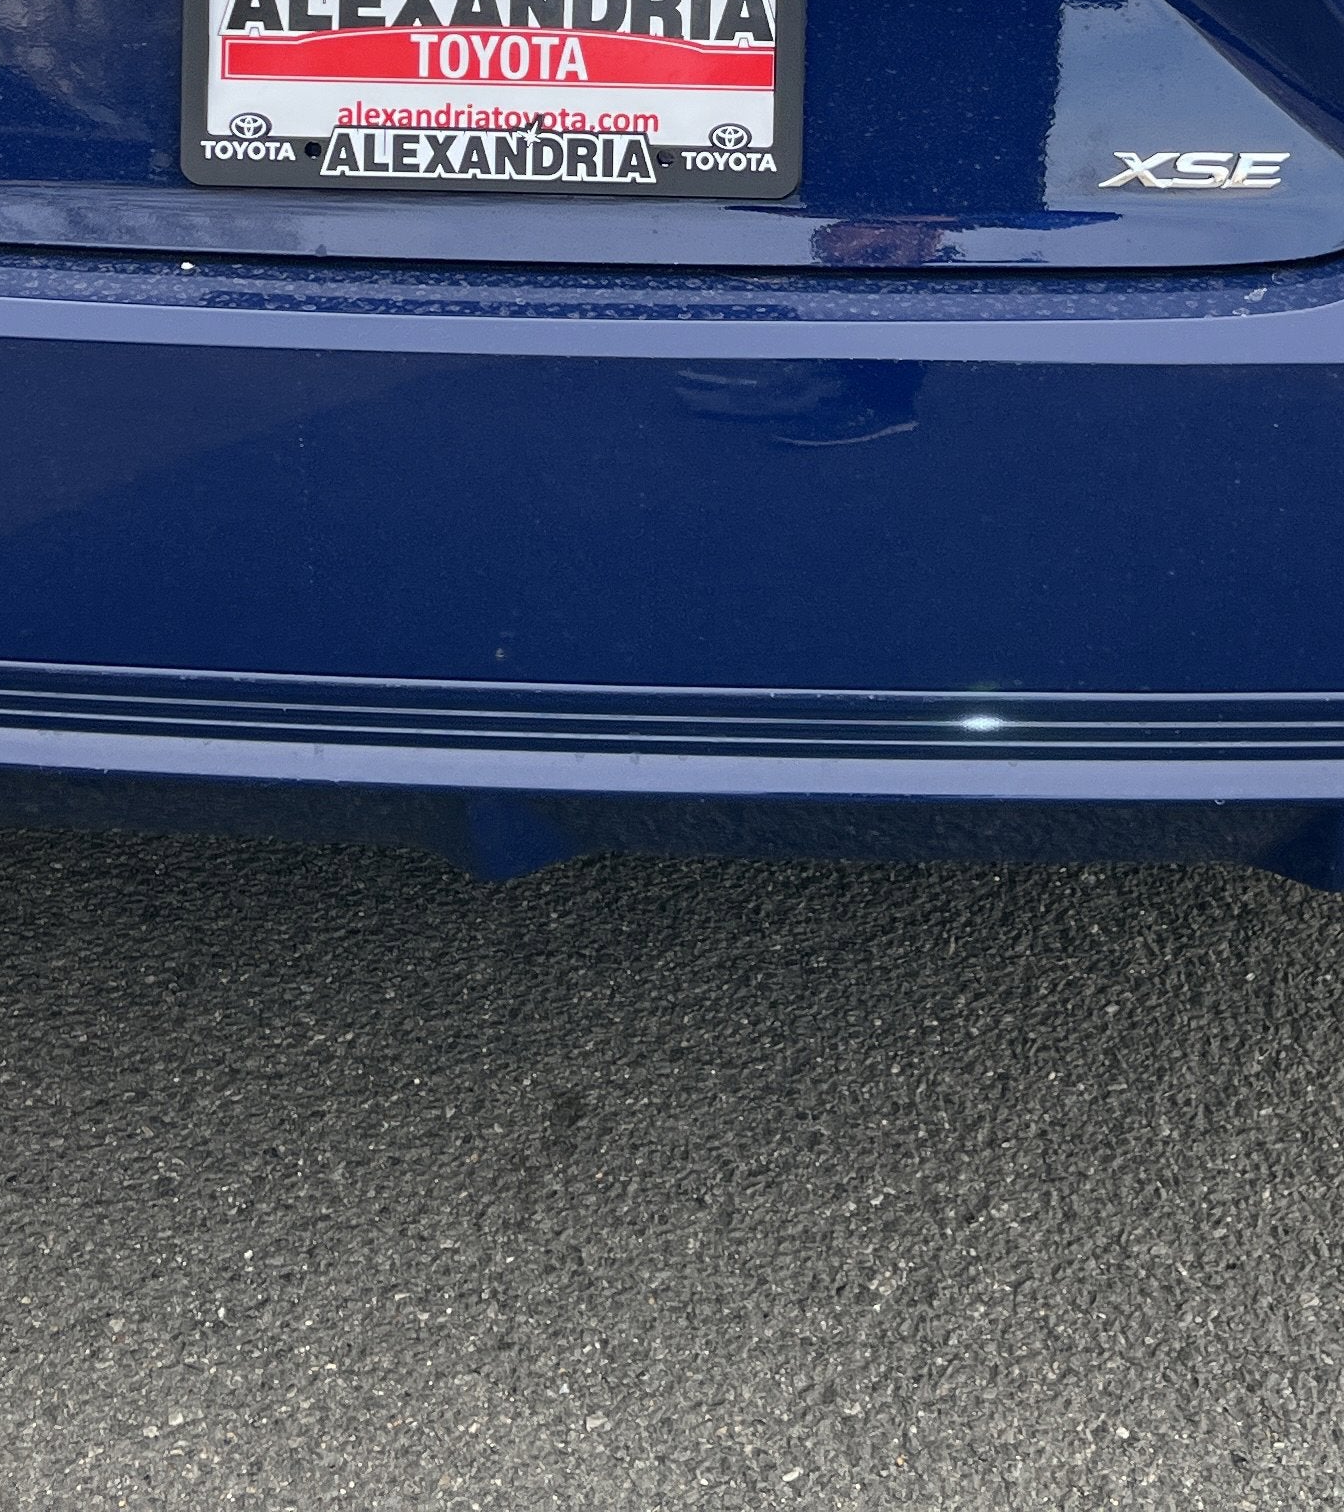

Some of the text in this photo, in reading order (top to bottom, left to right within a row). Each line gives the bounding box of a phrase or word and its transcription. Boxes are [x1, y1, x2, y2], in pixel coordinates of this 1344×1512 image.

[409, 33, 589, 81] TOYOTA
[200, 140, 296, 161] TOYOTA
[322, 130, 655, 182] ALEXANDRIA
[680, 150, 778, 172] TOYOTA
[1097, 151, 1291, 189] XSE
